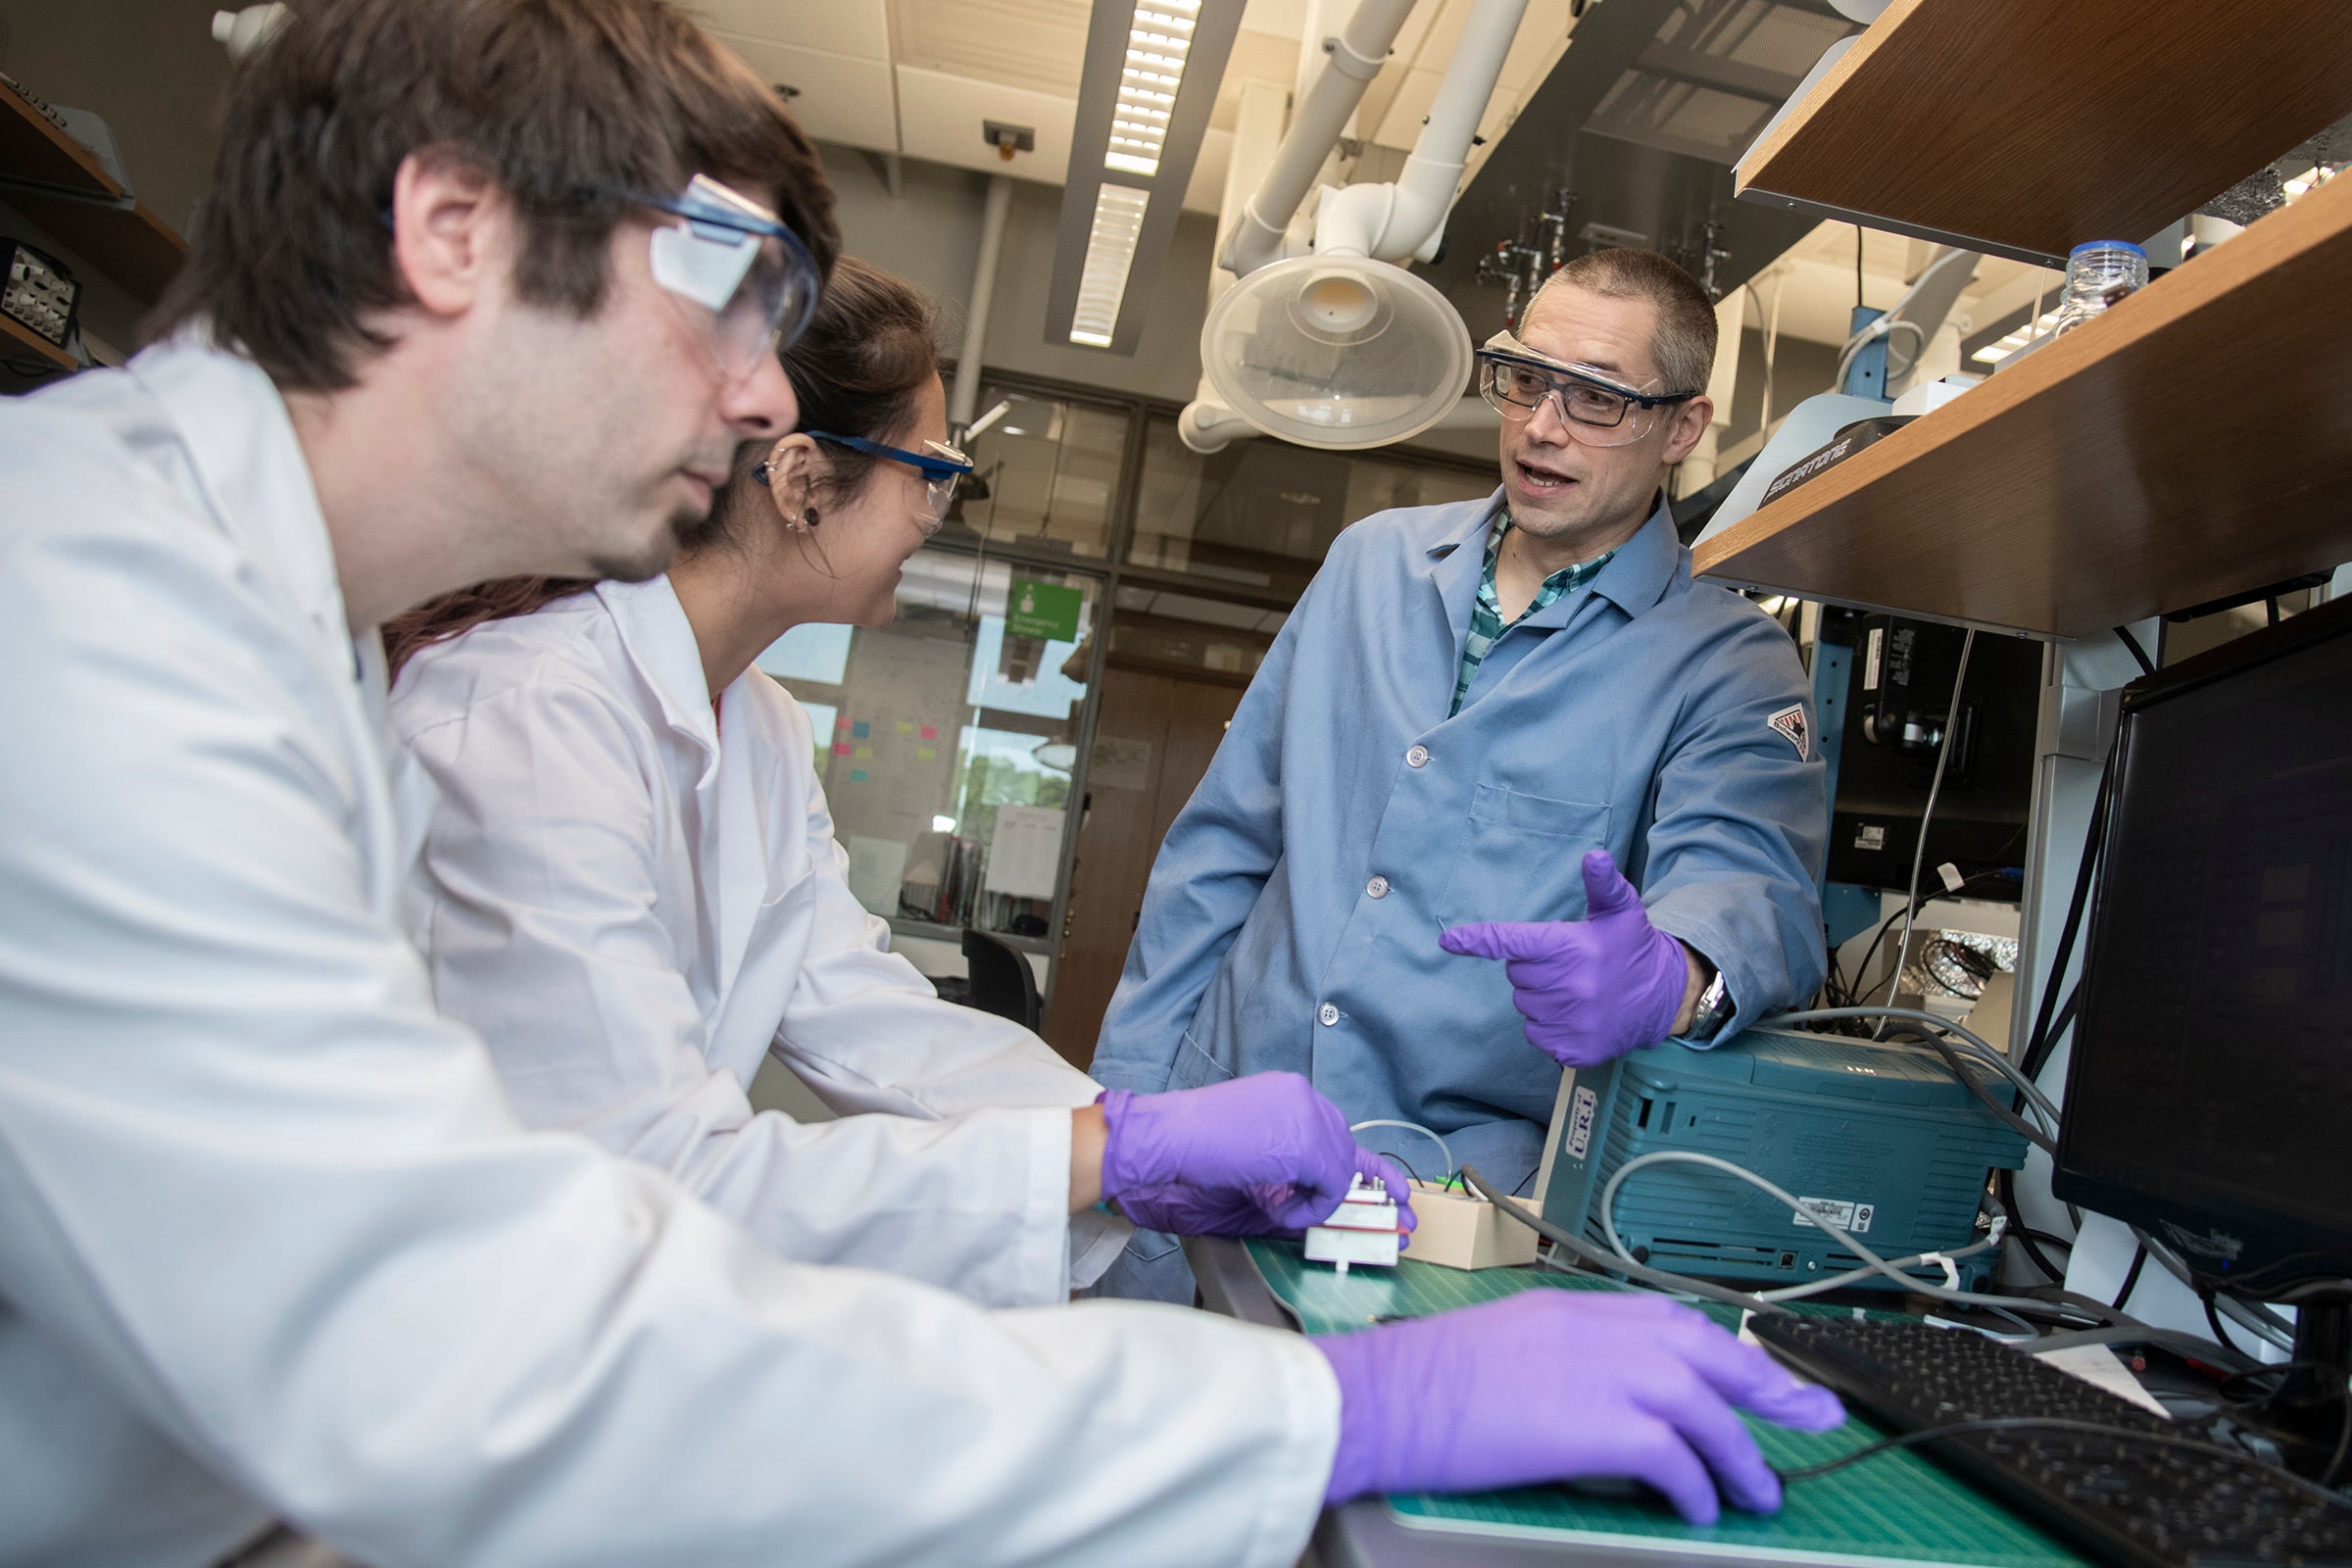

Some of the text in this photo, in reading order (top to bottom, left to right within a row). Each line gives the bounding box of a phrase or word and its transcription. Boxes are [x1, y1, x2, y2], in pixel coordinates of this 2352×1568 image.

[1763, 438, 1851, 503] SIGNATONE
[1569, 1106, 1582, 1147] Property
[1574, 1094, 1594, 1153] U.R.I.
